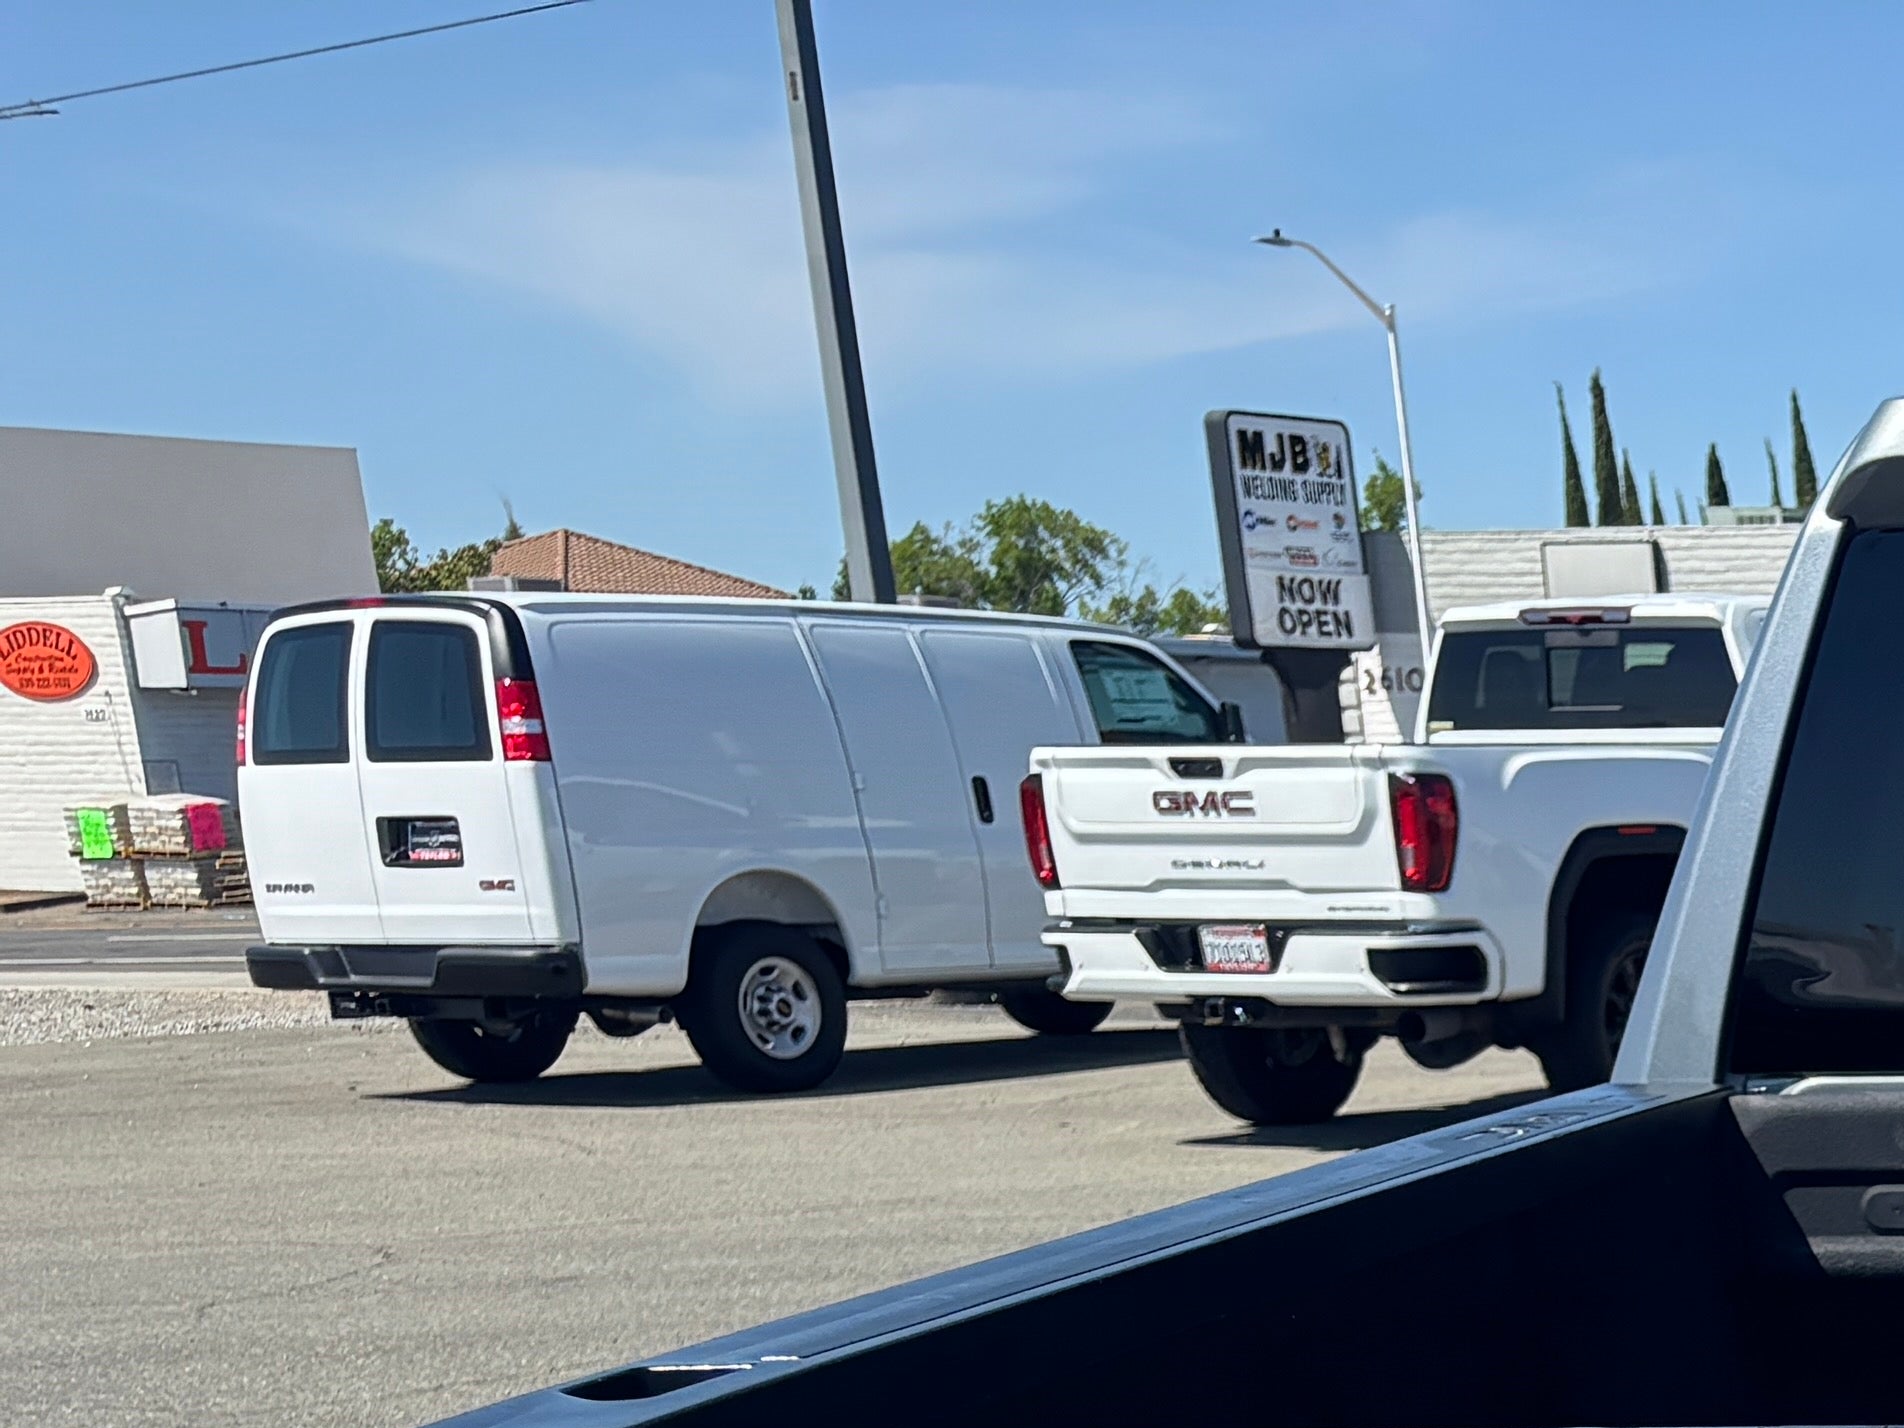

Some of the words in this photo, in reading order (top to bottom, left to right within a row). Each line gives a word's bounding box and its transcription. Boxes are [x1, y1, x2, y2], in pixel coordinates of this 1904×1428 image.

[1236, 428, 1310, 475] MJB
[1241, 474, 1297, 503] WELDING
[1301, 480, 1346, 507] SUPPLY
[1276, 575, 1342, 606] NOW
[1277, 606, 1354, 639] OPEN
[1363, 666, 1425, 694] 2610
[1152, 790, 1256, 818] GMC
